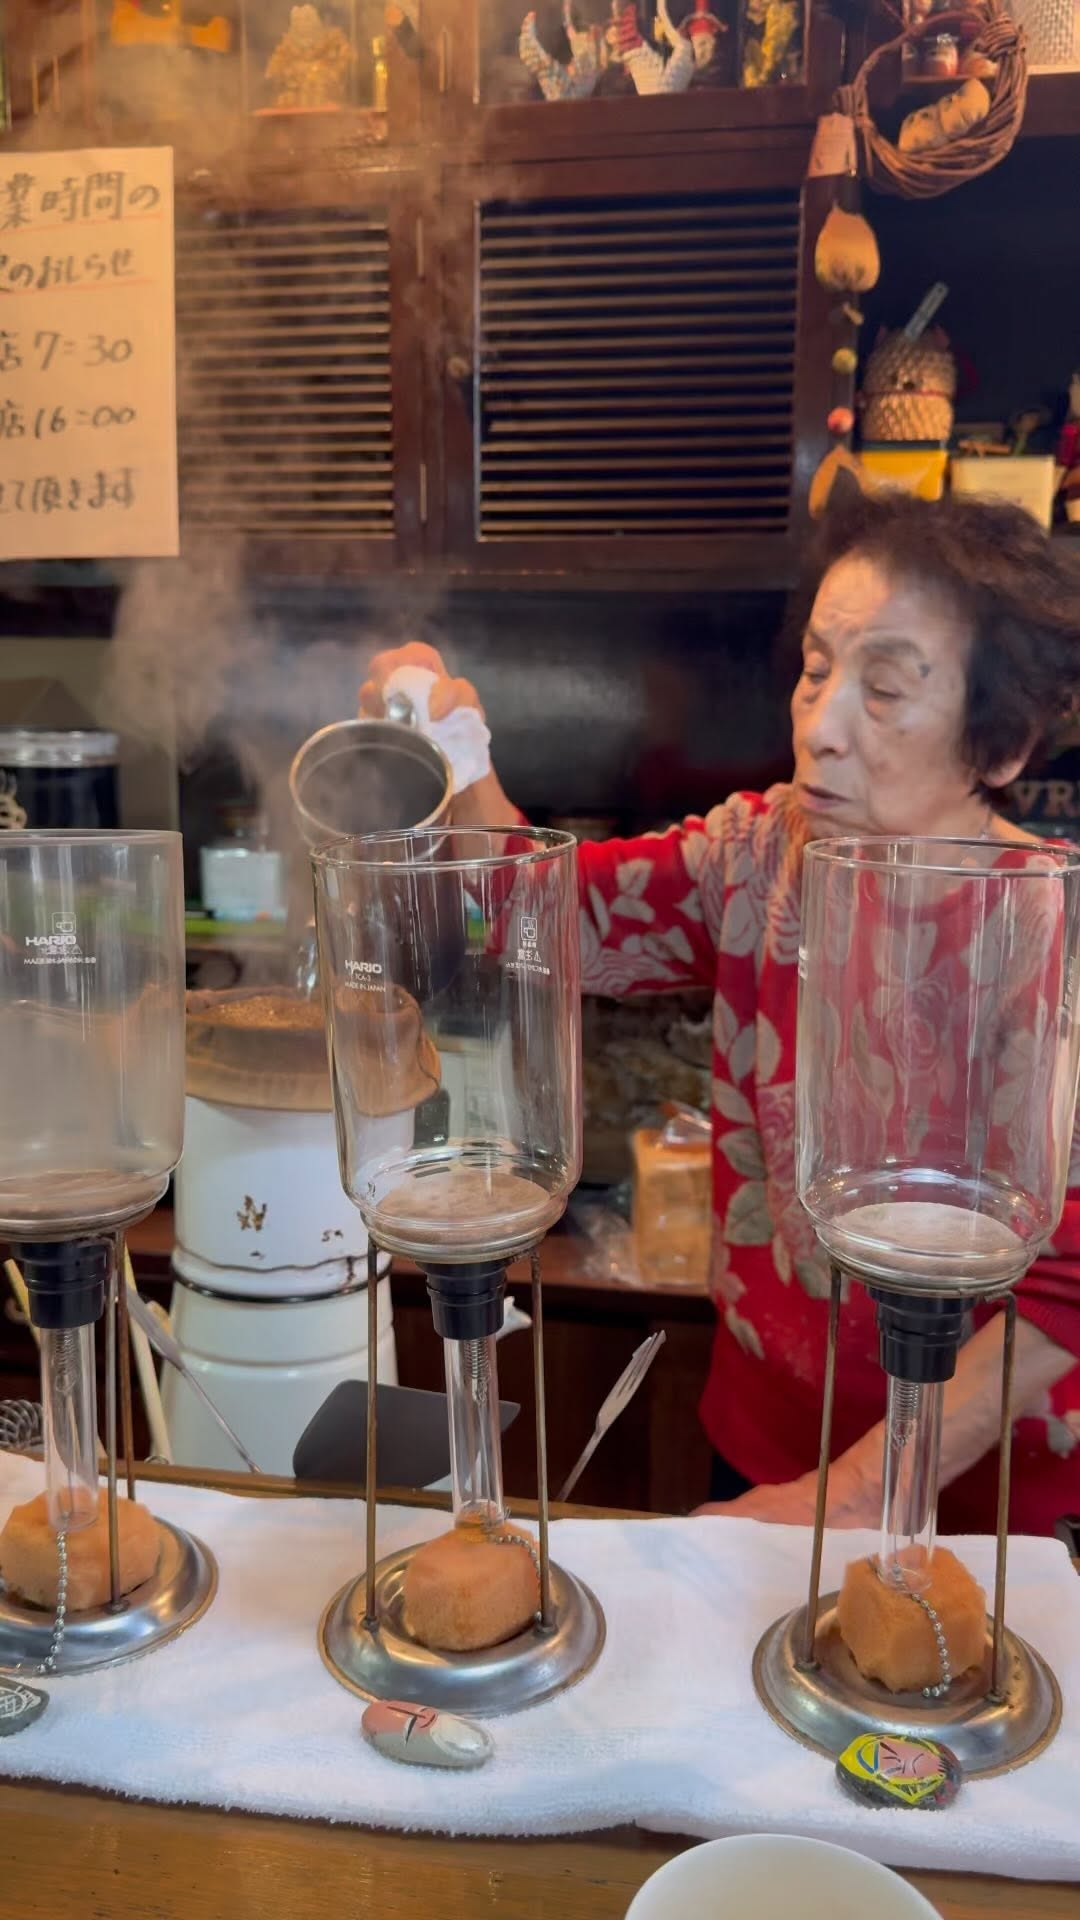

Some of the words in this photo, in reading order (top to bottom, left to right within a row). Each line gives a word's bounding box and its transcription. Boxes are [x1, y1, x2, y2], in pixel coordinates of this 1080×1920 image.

[0, 248, 136, 292] のおしらせ
[0, 467, 140, 514] て頂きます
[25, 935, 77, 946] HARIO
[344, 959, 382, 974] HARIO
